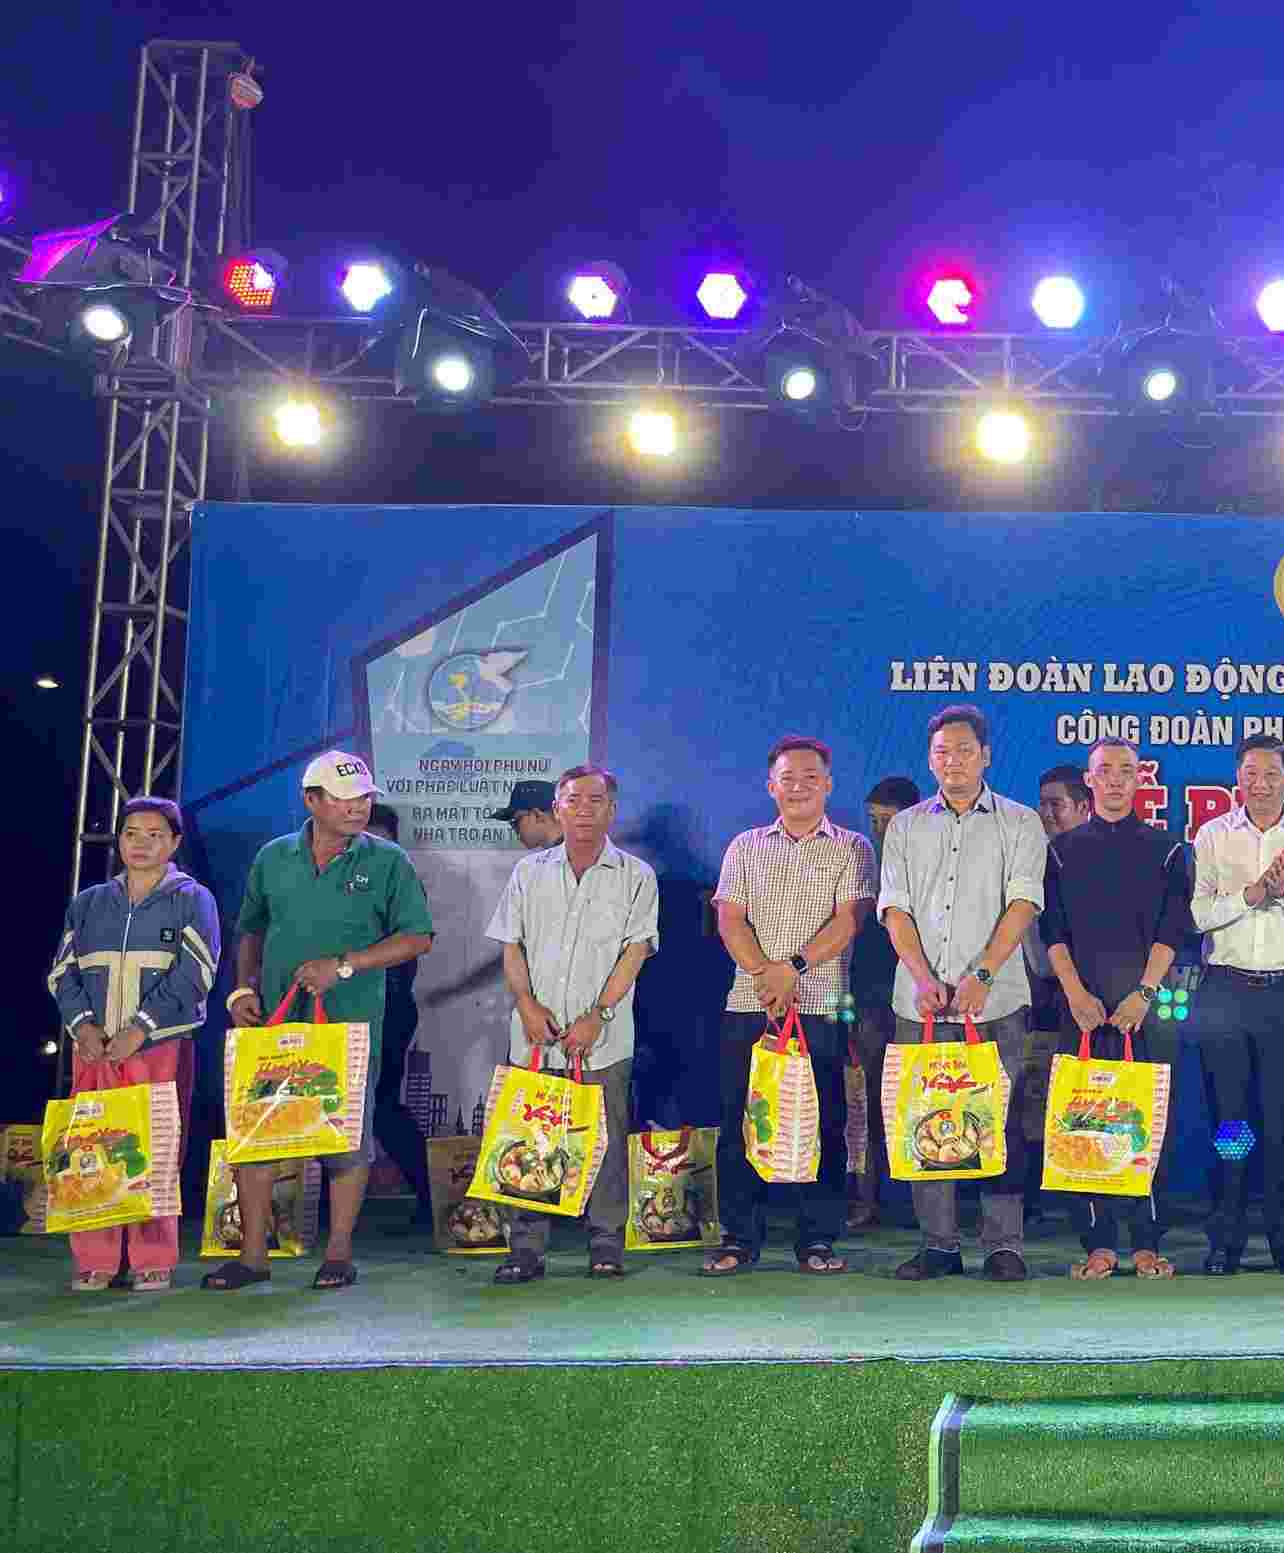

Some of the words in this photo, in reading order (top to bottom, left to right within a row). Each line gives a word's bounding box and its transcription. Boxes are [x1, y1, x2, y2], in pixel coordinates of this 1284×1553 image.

[890, 655, 978, 692] LIÊN
[987, 655, 1093, 693] ĐOÀN
[1103, 663, 1175, 694] LAO
[1056, 709, 1140, 745] CÔNG
[1148, 710, 1233, 746] ĐOÀN
